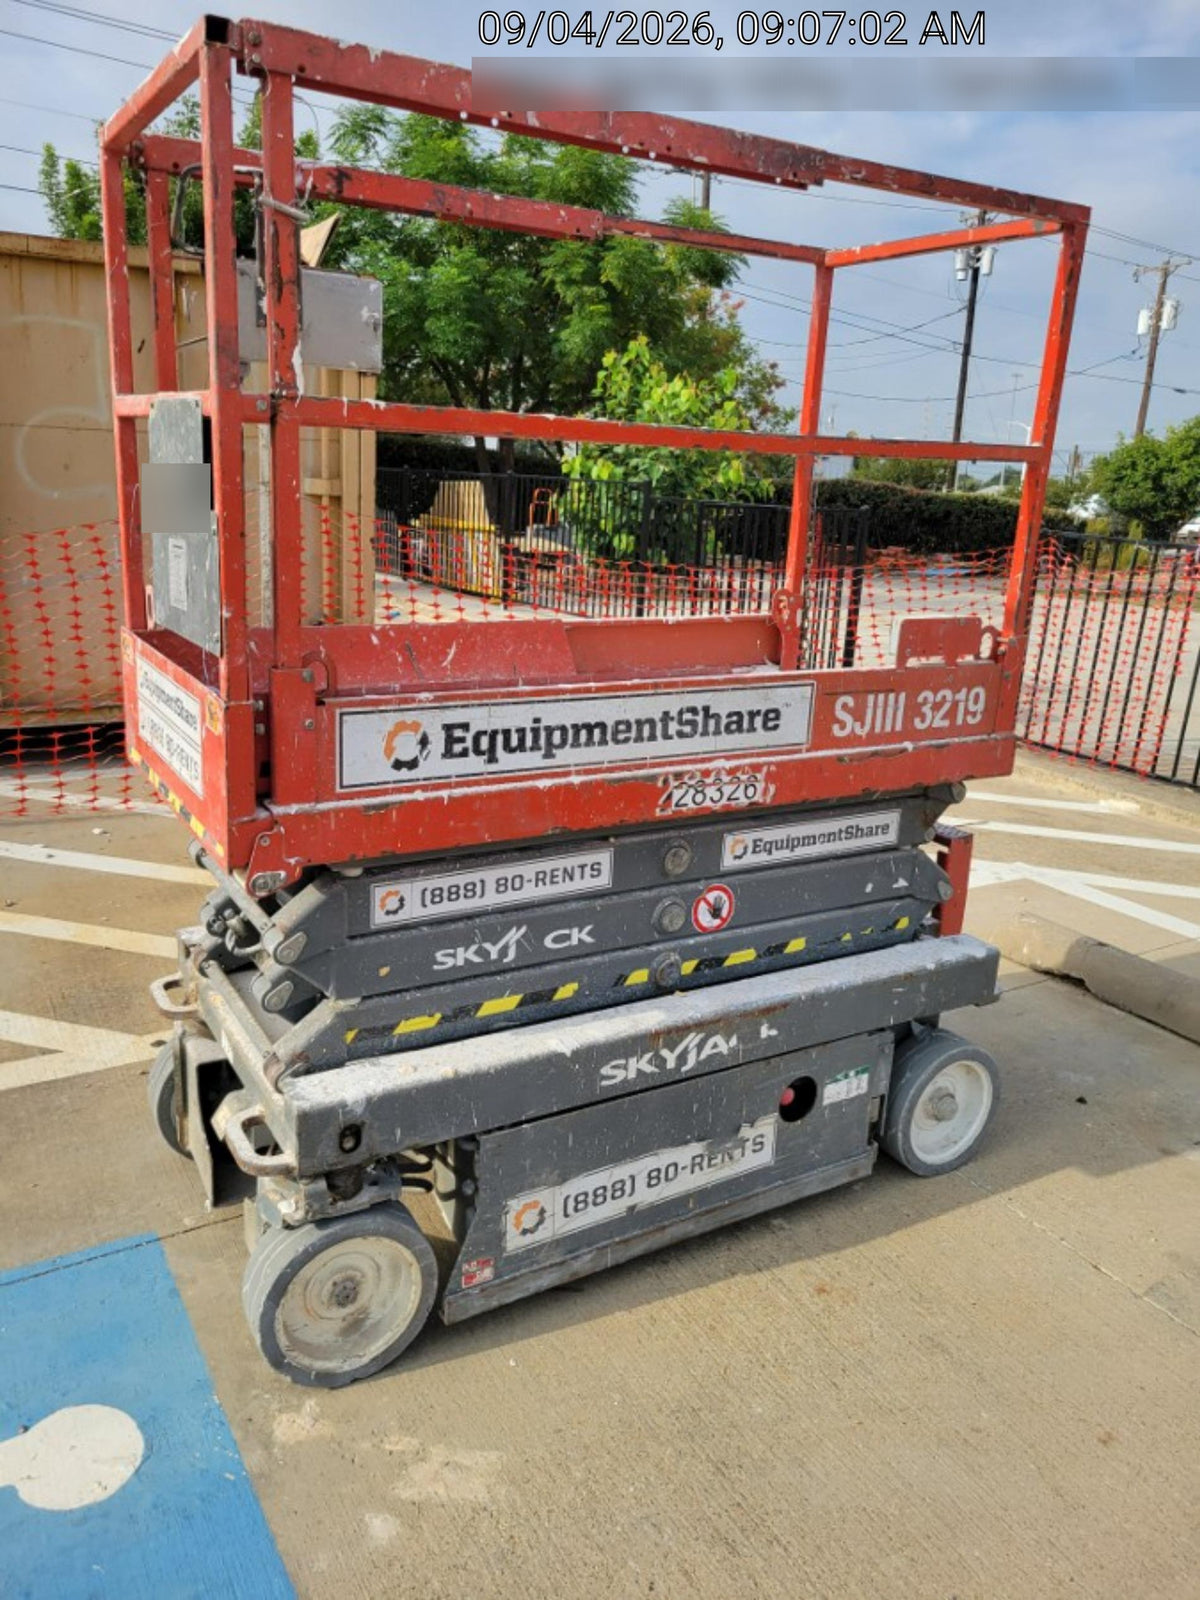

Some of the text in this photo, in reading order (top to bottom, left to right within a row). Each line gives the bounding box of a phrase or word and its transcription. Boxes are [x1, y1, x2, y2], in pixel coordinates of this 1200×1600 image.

[914, 686, 985, 730] 3219
[441, 705, 783, 765] EquipmentShare
[672, 774, 760, 809] 28326
[751, 823, 890, 855] EquipmentShare
[421, 862, 602, 908] (888) 80-RENTS
[433, 924, 596, 970] SKYJCK
[563, 1133, 765, 1218] (888) 80-RENTS
